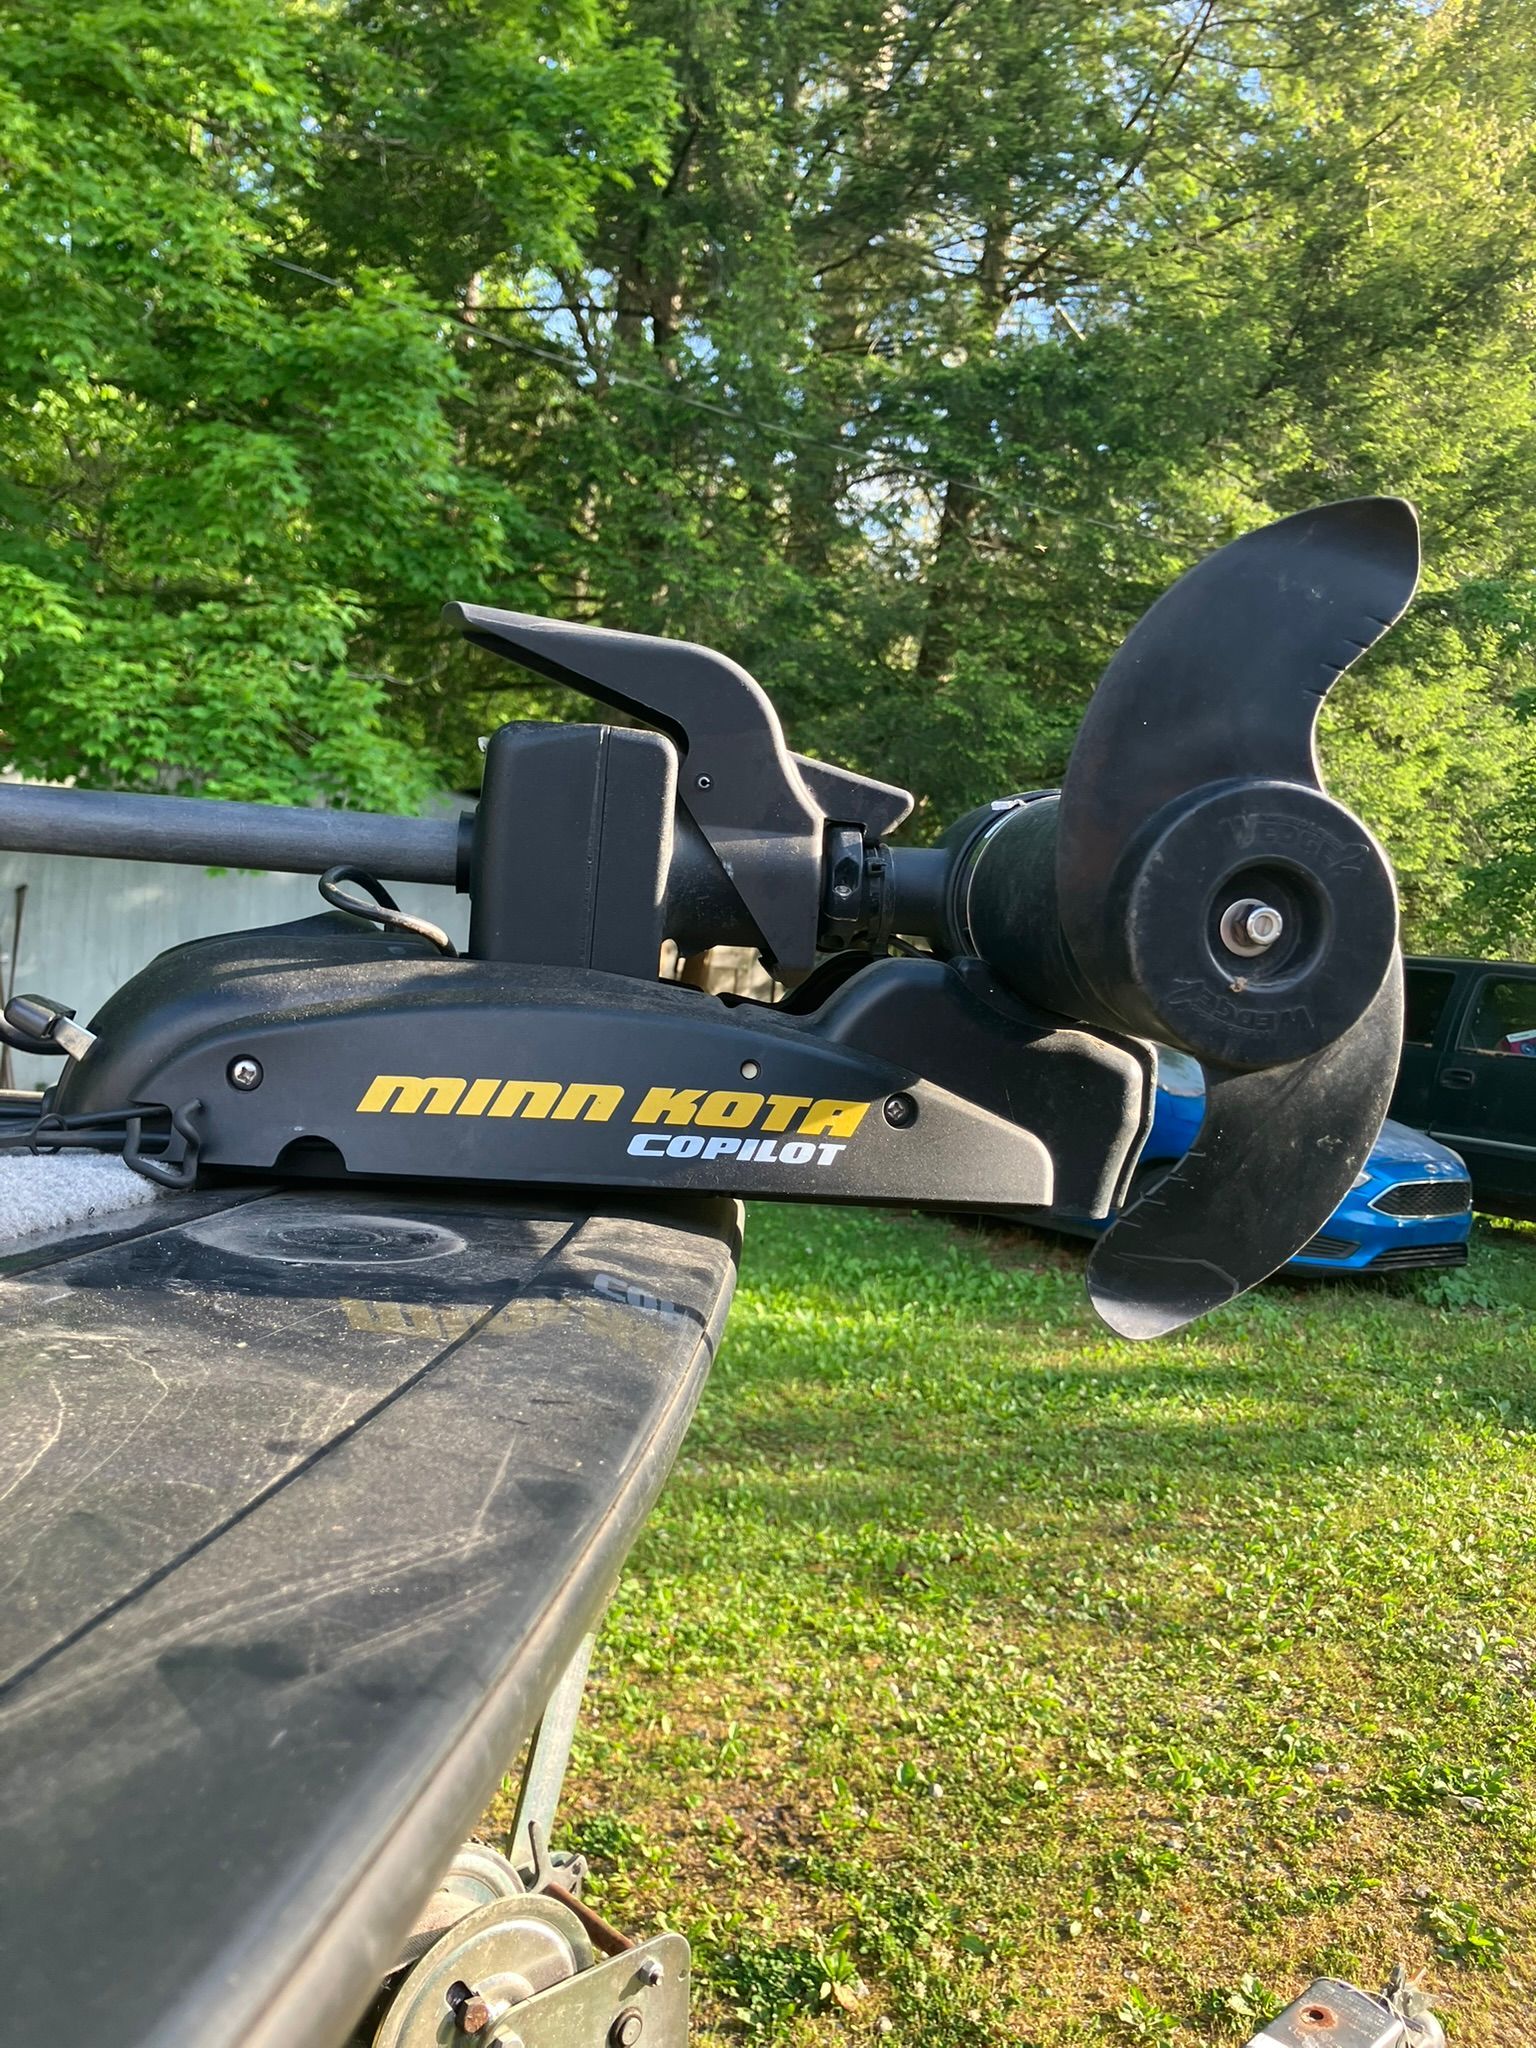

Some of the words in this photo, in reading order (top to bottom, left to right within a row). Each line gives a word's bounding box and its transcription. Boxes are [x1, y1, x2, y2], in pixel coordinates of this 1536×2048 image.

[356, 1076, 625, 1121] MINN
[631, 1087, 871, 1137] KOTA
[627, 1133, 847, 1166] COPILOT
